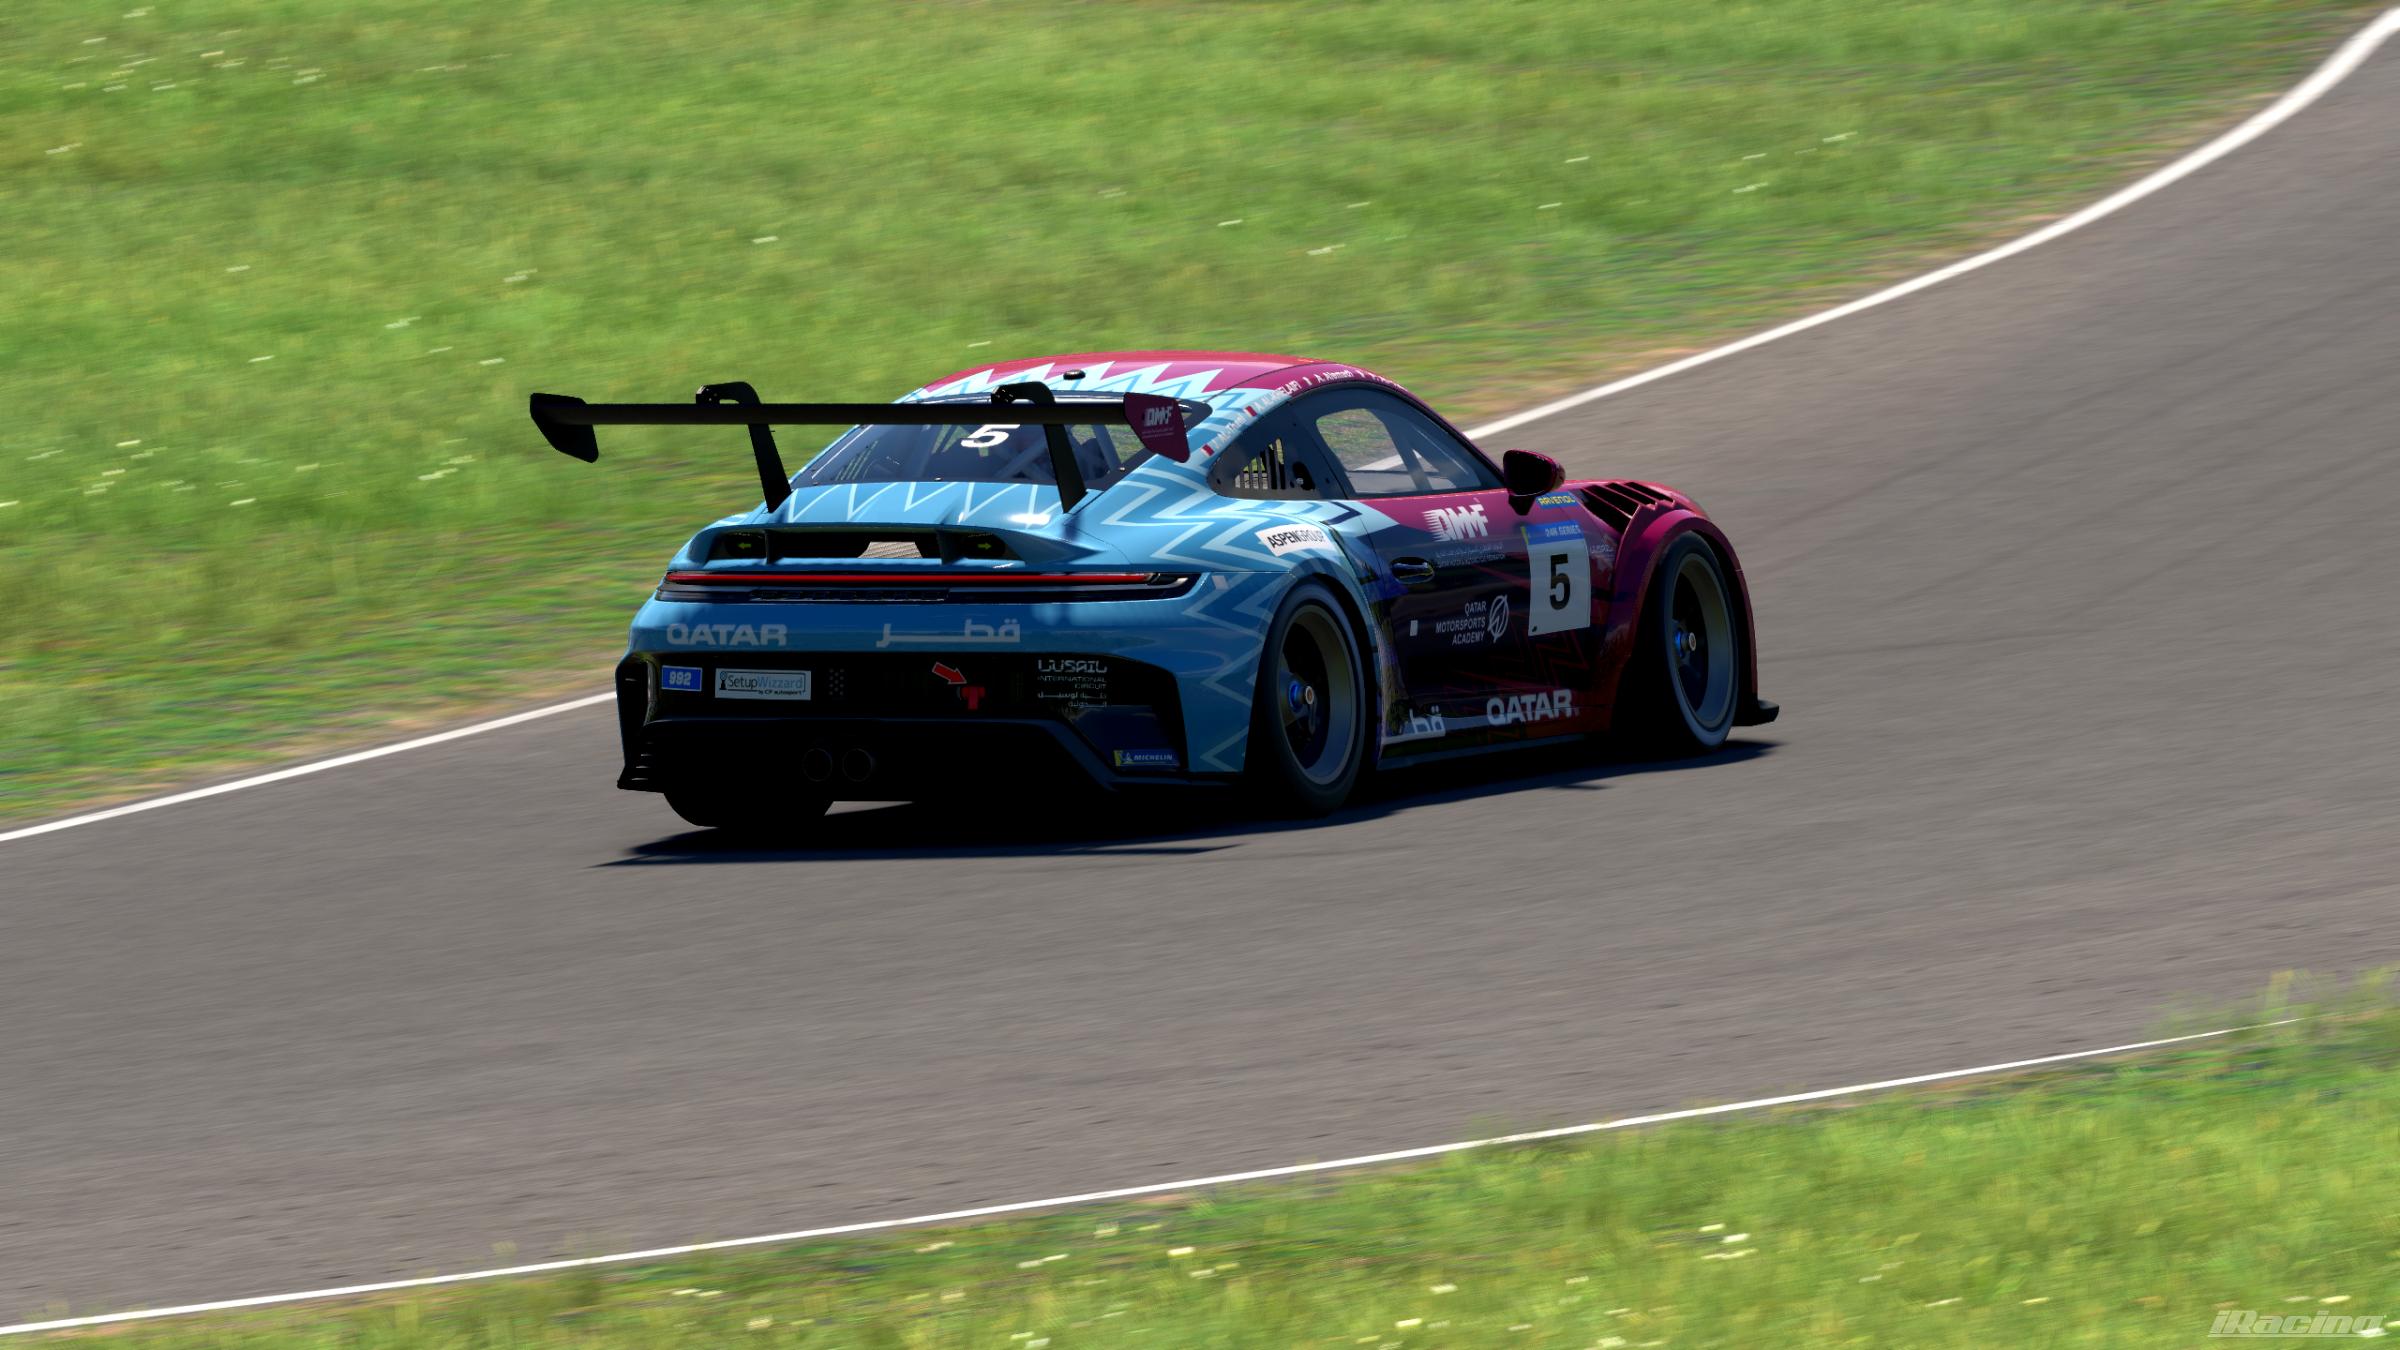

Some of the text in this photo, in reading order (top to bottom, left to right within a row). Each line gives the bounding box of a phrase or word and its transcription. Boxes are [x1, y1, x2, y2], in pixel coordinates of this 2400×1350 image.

[960, 423, 1021, 448] 5
[1549, 553, 1571, 610] 5
[1464, 601, 1487, 617] QATAR
[876, 618, 1021, 649] قطر
[1435, 616, 1486, 634] MOTORSPORTS
[666, 623, 788, 647] QATAR
[1451, 632, 1485, 646] ACADEMY
[1037, 659, 1108, 674] LUSAIL
[668, 671, 692, 687] 992
[1037, 675, 1106, 683] INTERNATIONAL
[1486, 689, 1574, 726] QATAR
